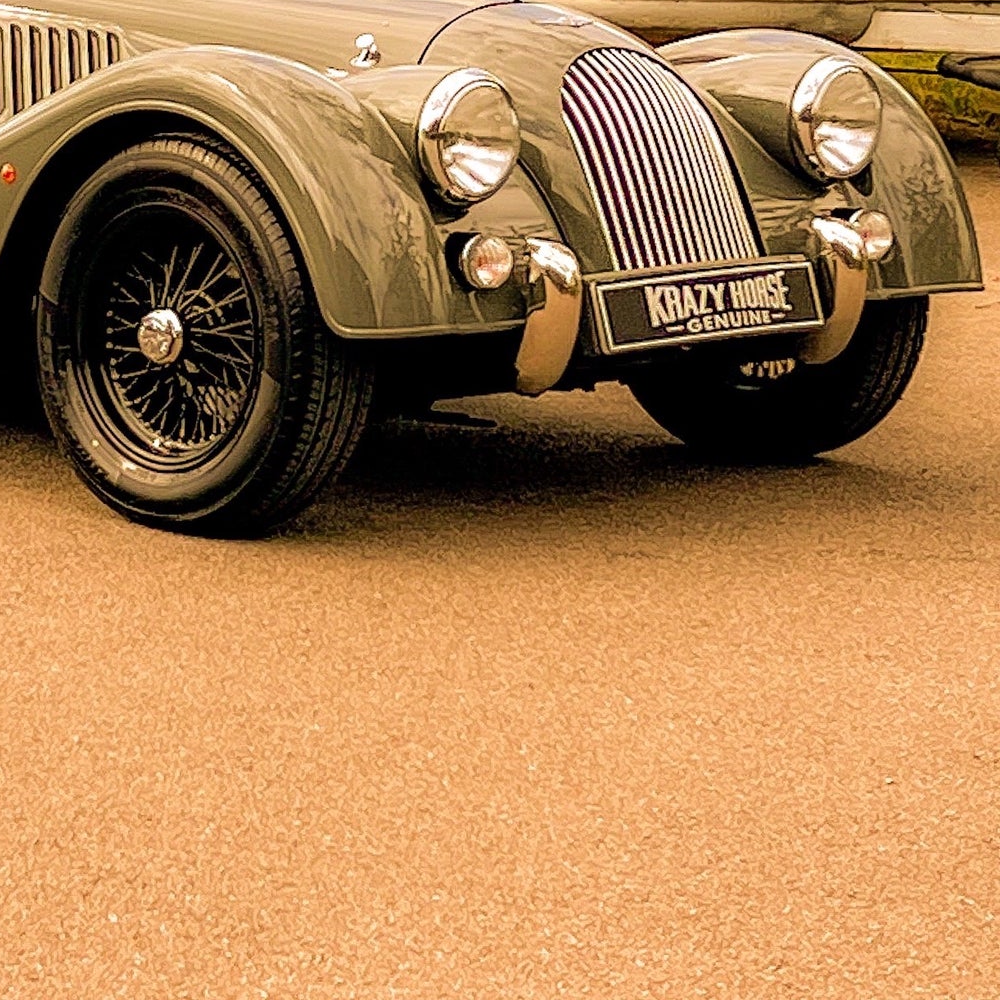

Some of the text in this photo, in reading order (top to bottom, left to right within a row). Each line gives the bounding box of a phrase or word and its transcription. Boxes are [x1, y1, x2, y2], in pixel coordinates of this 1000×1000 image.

[644, 270, 793, 328] KRAZY HORSE
[686, 309, 772, 333] GENUINE
